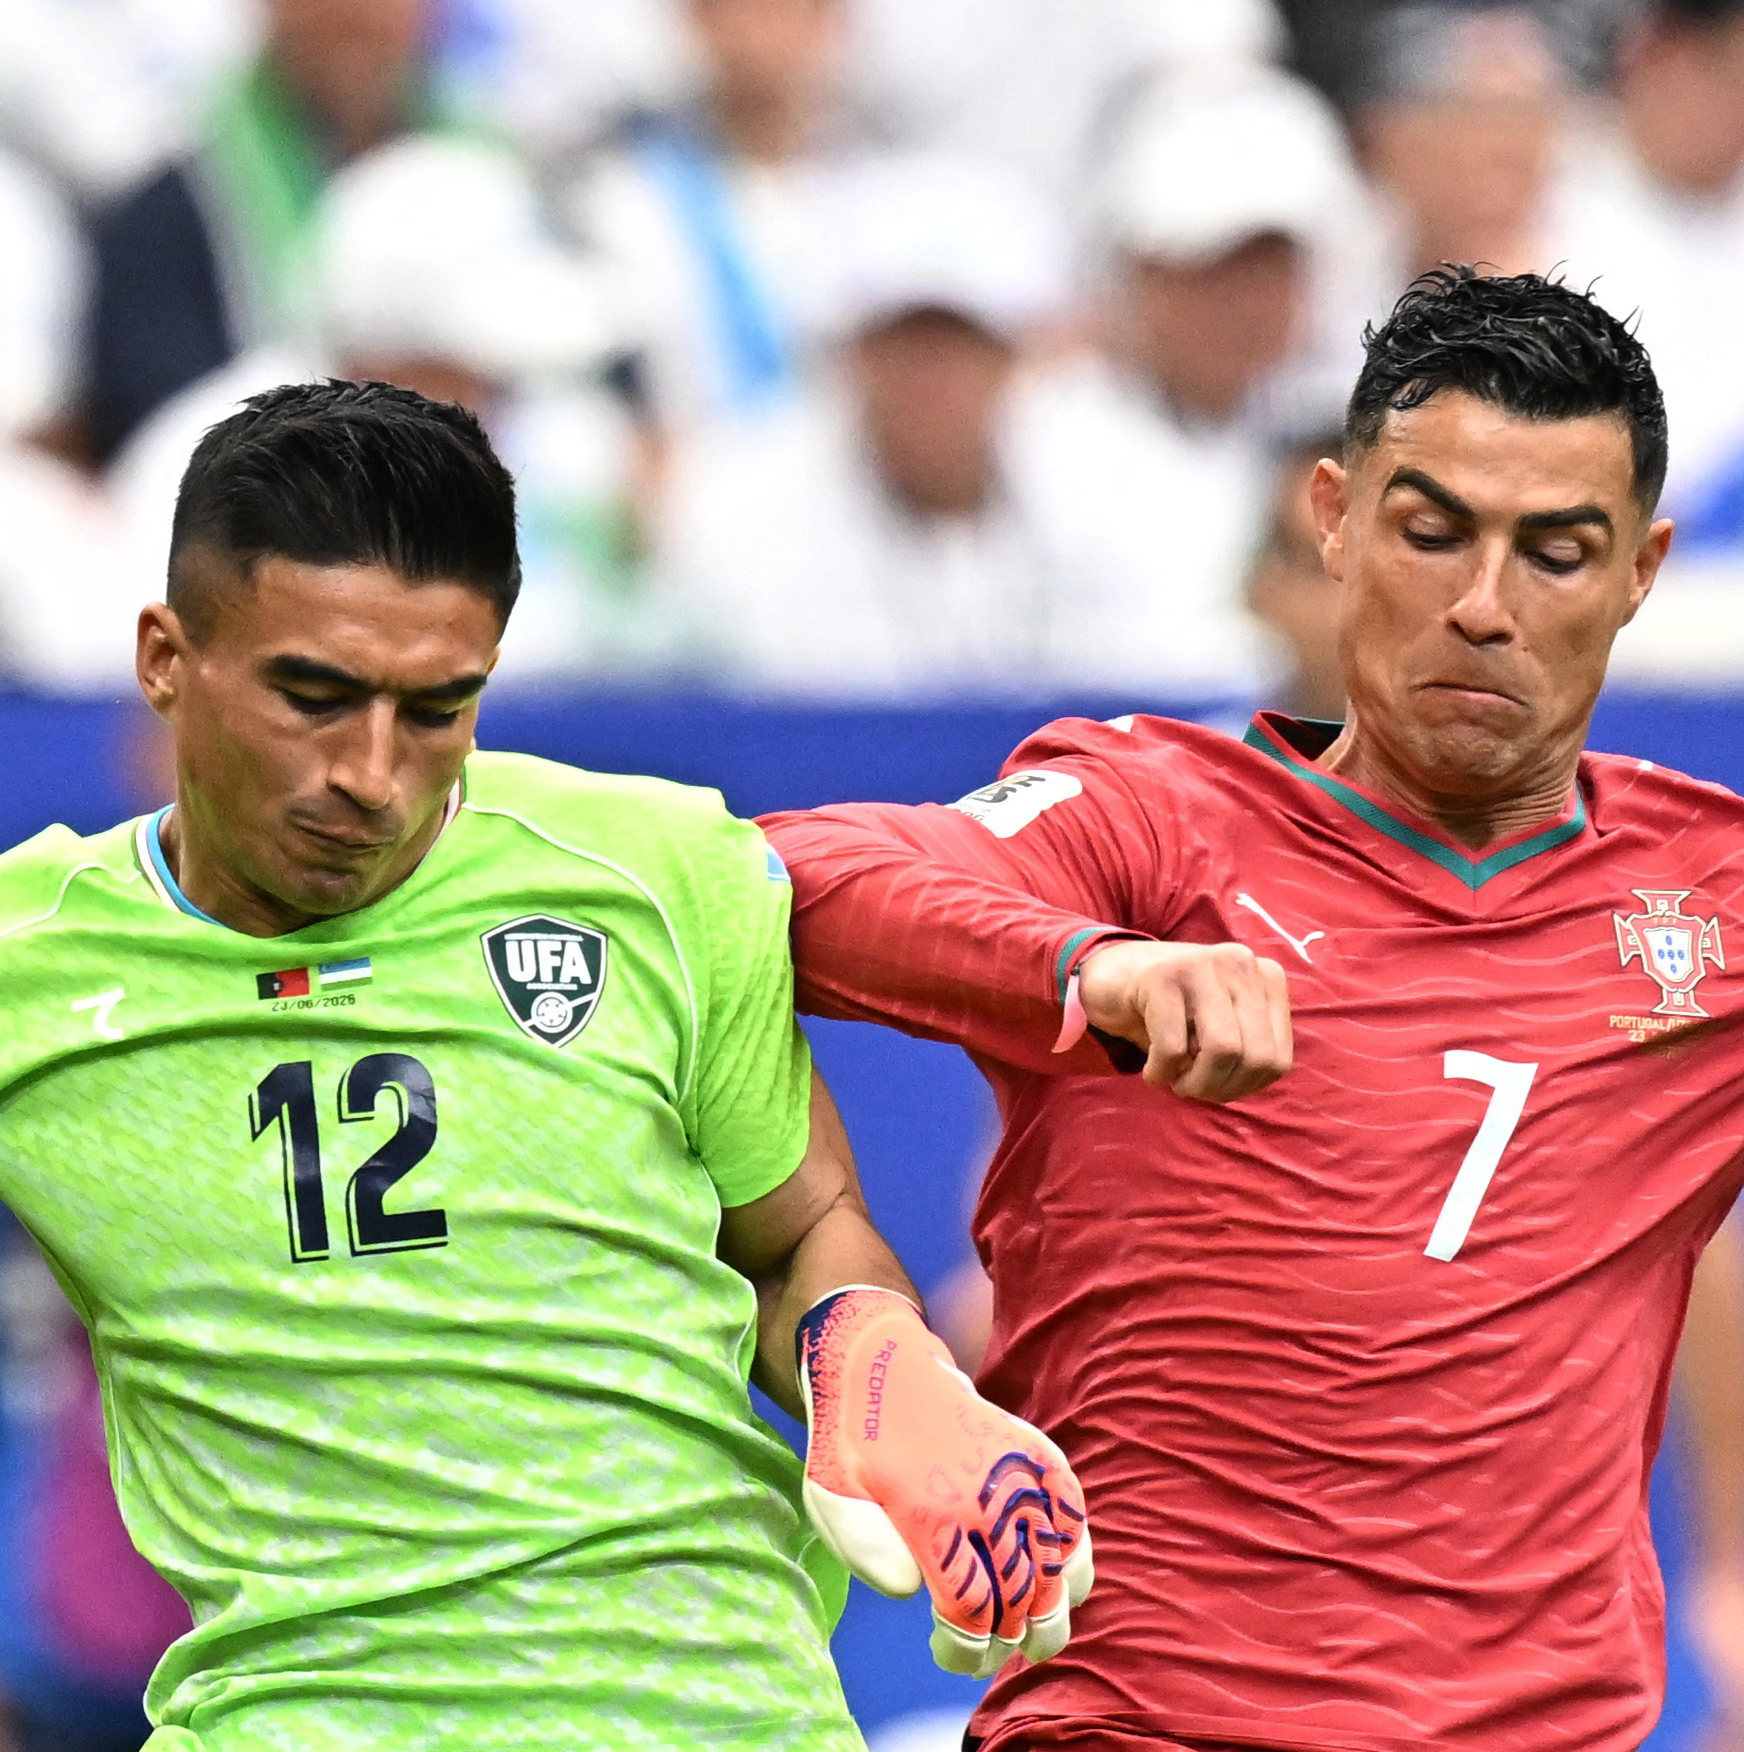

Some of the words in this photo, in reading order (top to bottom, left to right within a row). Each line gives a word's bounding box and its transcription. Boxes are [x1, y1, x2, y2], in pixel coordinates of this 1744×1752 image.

[505, 939, 593, 985] UFA
[248, 1052, 449, 1264] 12
[1423, 1049, 1540, 1263] 7
[862, 1338, 899, 1443] PREDATOR
